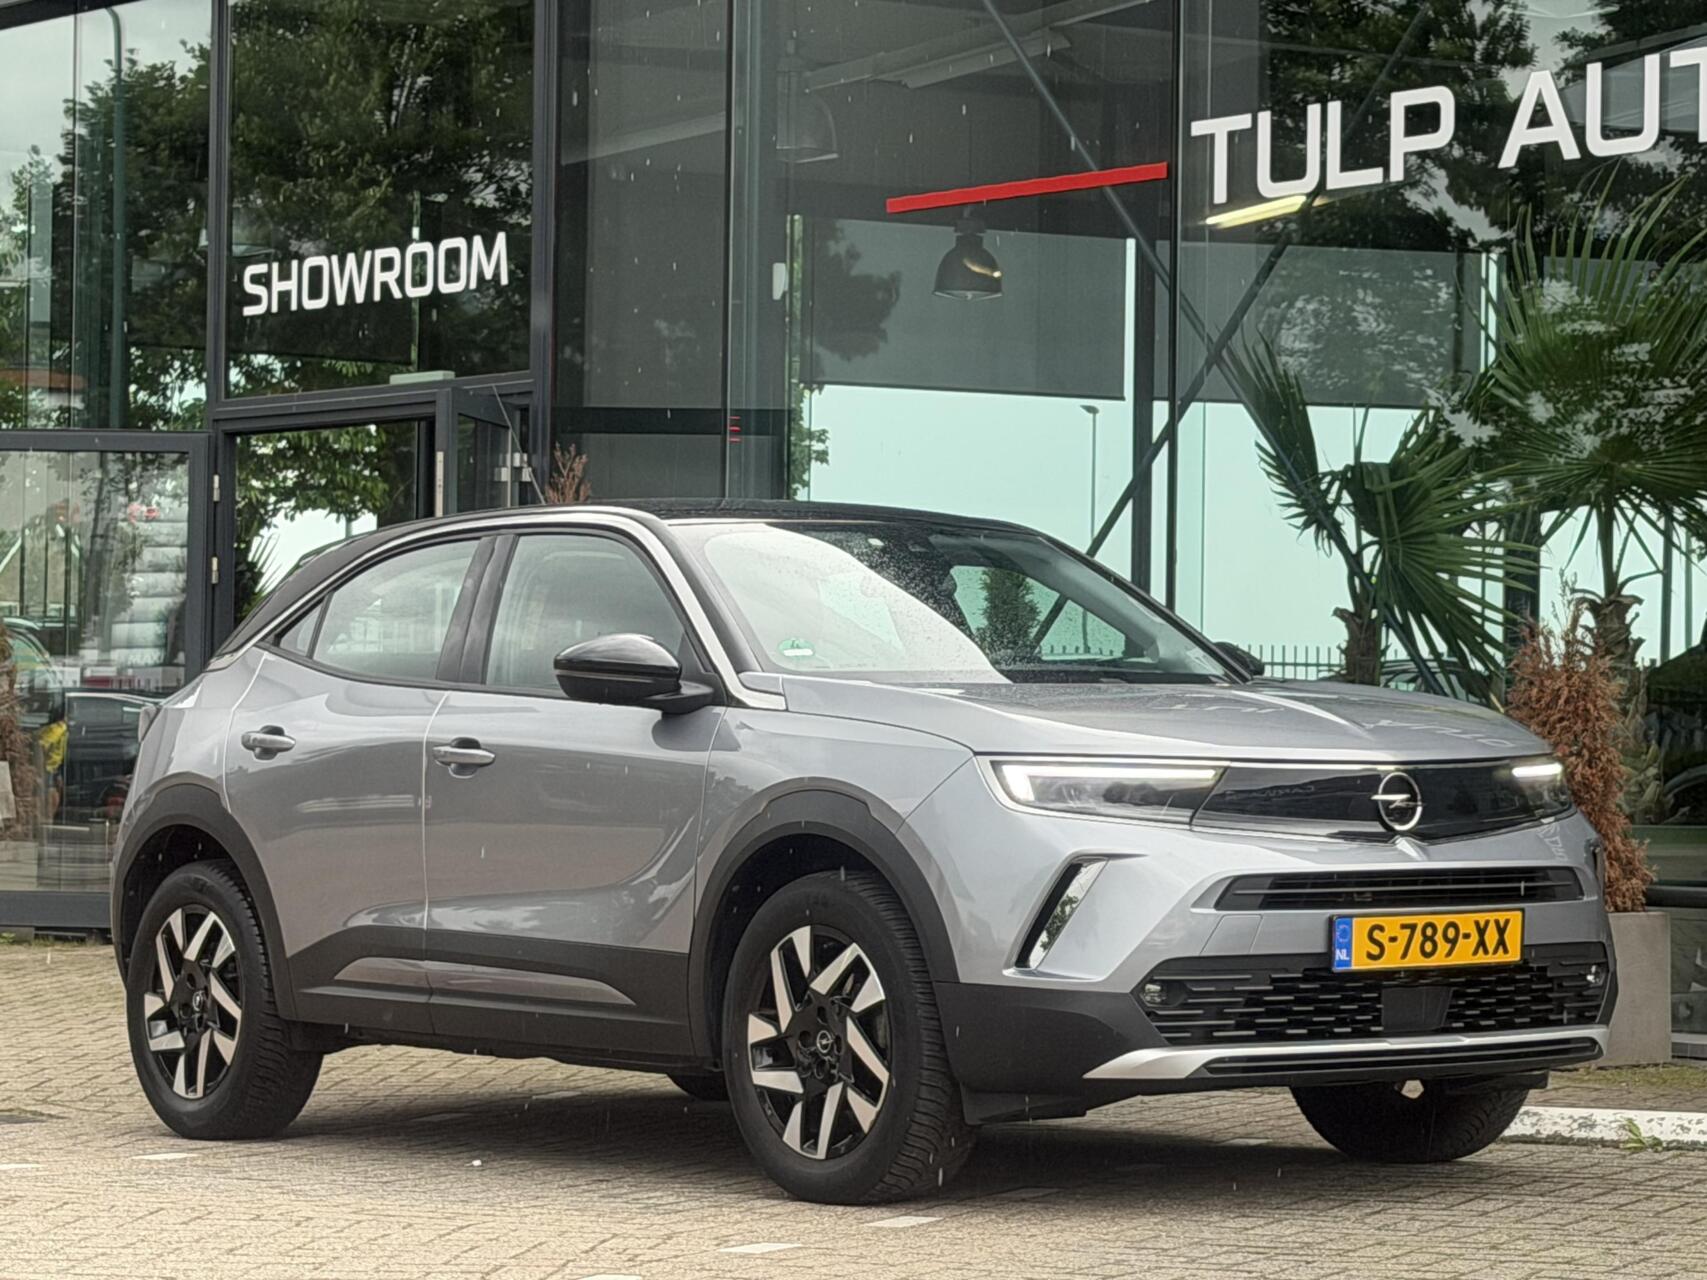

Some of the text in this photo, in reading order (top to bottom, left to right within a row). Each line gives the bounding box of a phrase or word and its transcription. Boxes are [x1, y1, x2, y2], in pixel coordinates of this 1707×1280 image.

[1190, 86, 1455, 204] TULP
[243, 231, 509, 316] SHOWROOM
[1335, 948, 1350, 960] NL
[1366, 918, 1511, 961] S-789-XX
